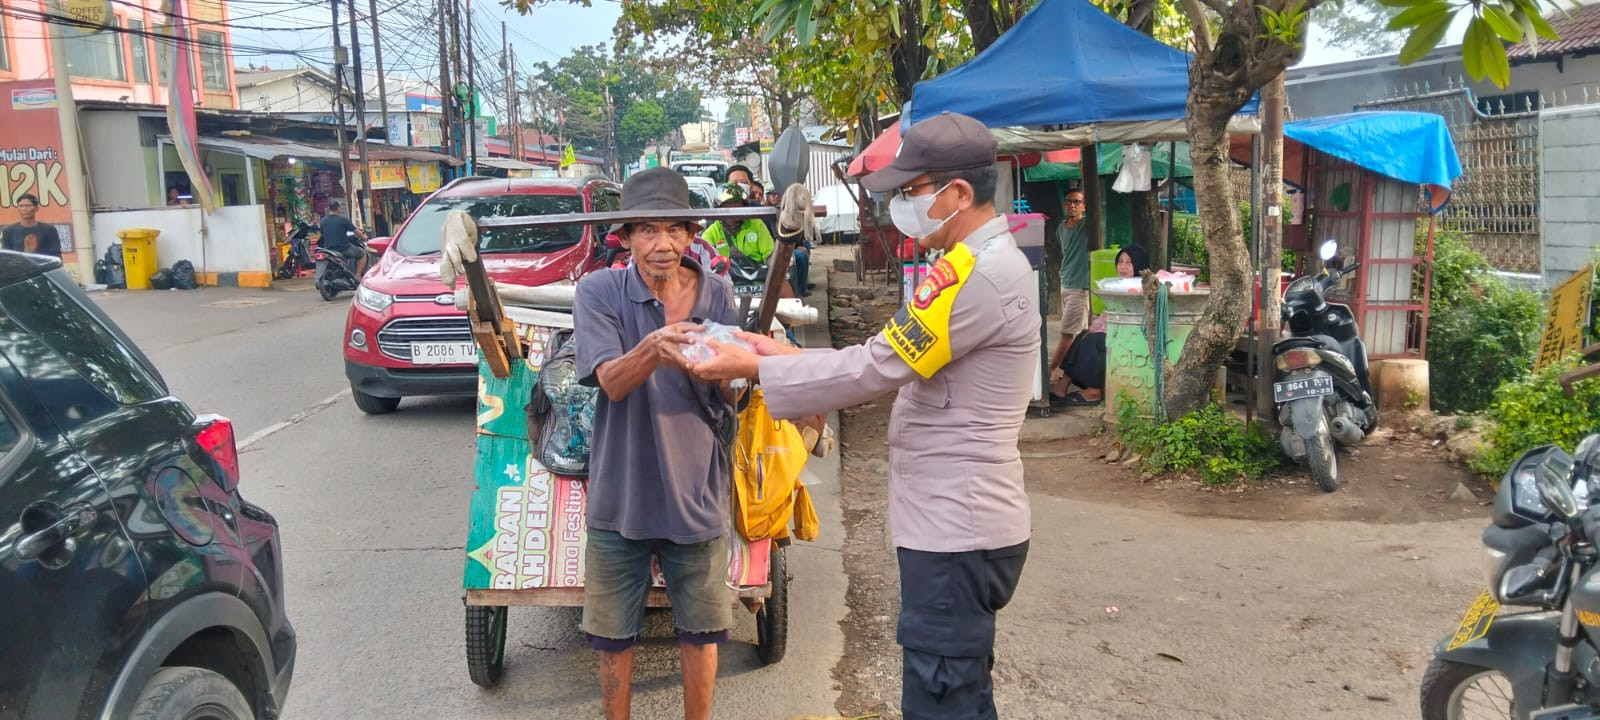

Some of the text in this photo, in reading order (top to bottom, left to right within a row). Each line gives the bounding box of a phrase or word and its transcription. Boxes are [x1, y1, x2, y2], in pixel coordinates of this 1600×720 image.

[0, 148, 27, 162] Mulai
[413, 344, 421, 357] B
[426, 344, 455, 357] 2086
[562, 479, 584, 543] Festive
